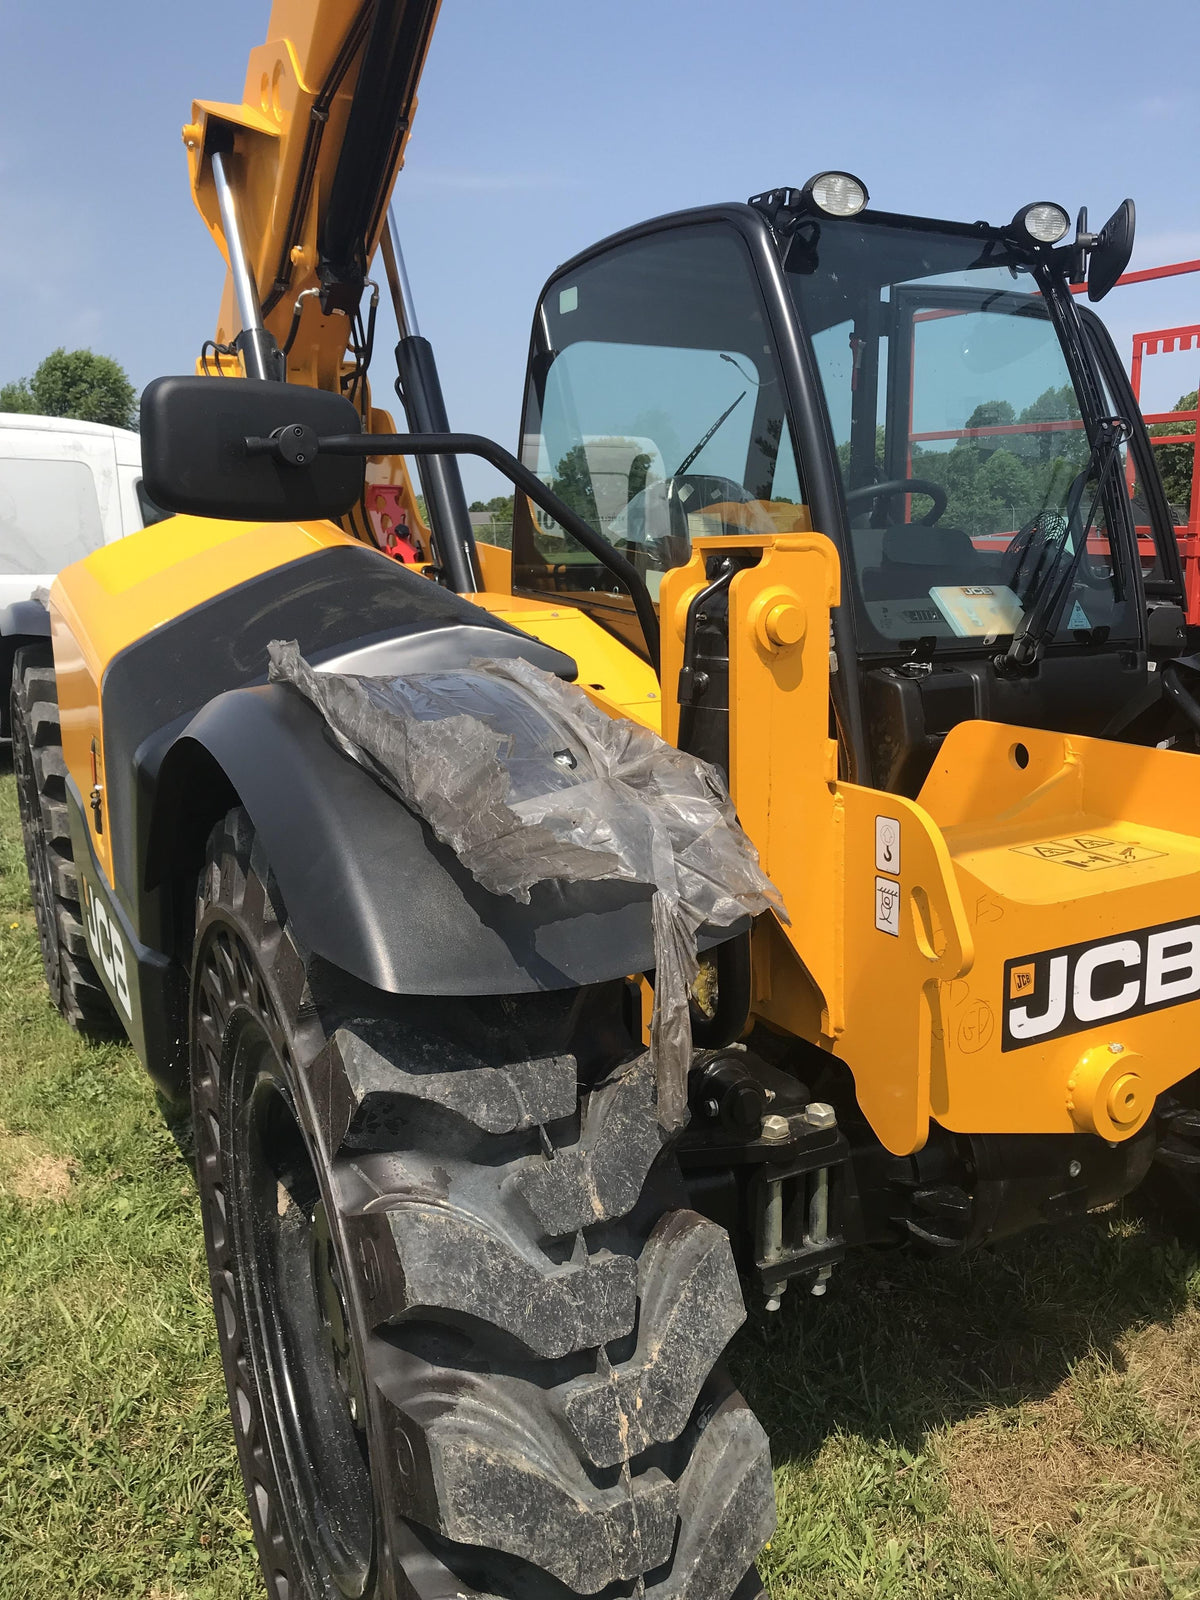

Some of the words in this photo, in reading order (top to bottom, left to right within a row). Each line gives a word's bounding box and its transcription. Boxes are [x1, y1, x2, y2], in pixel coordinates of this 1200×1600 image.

[963, 587, 993, 595] JCB
[87, 885, 133, 1022] JCB
[1008, 924, 1200, 1040] JCB
[1016, 974, 1031, 989] JCB
